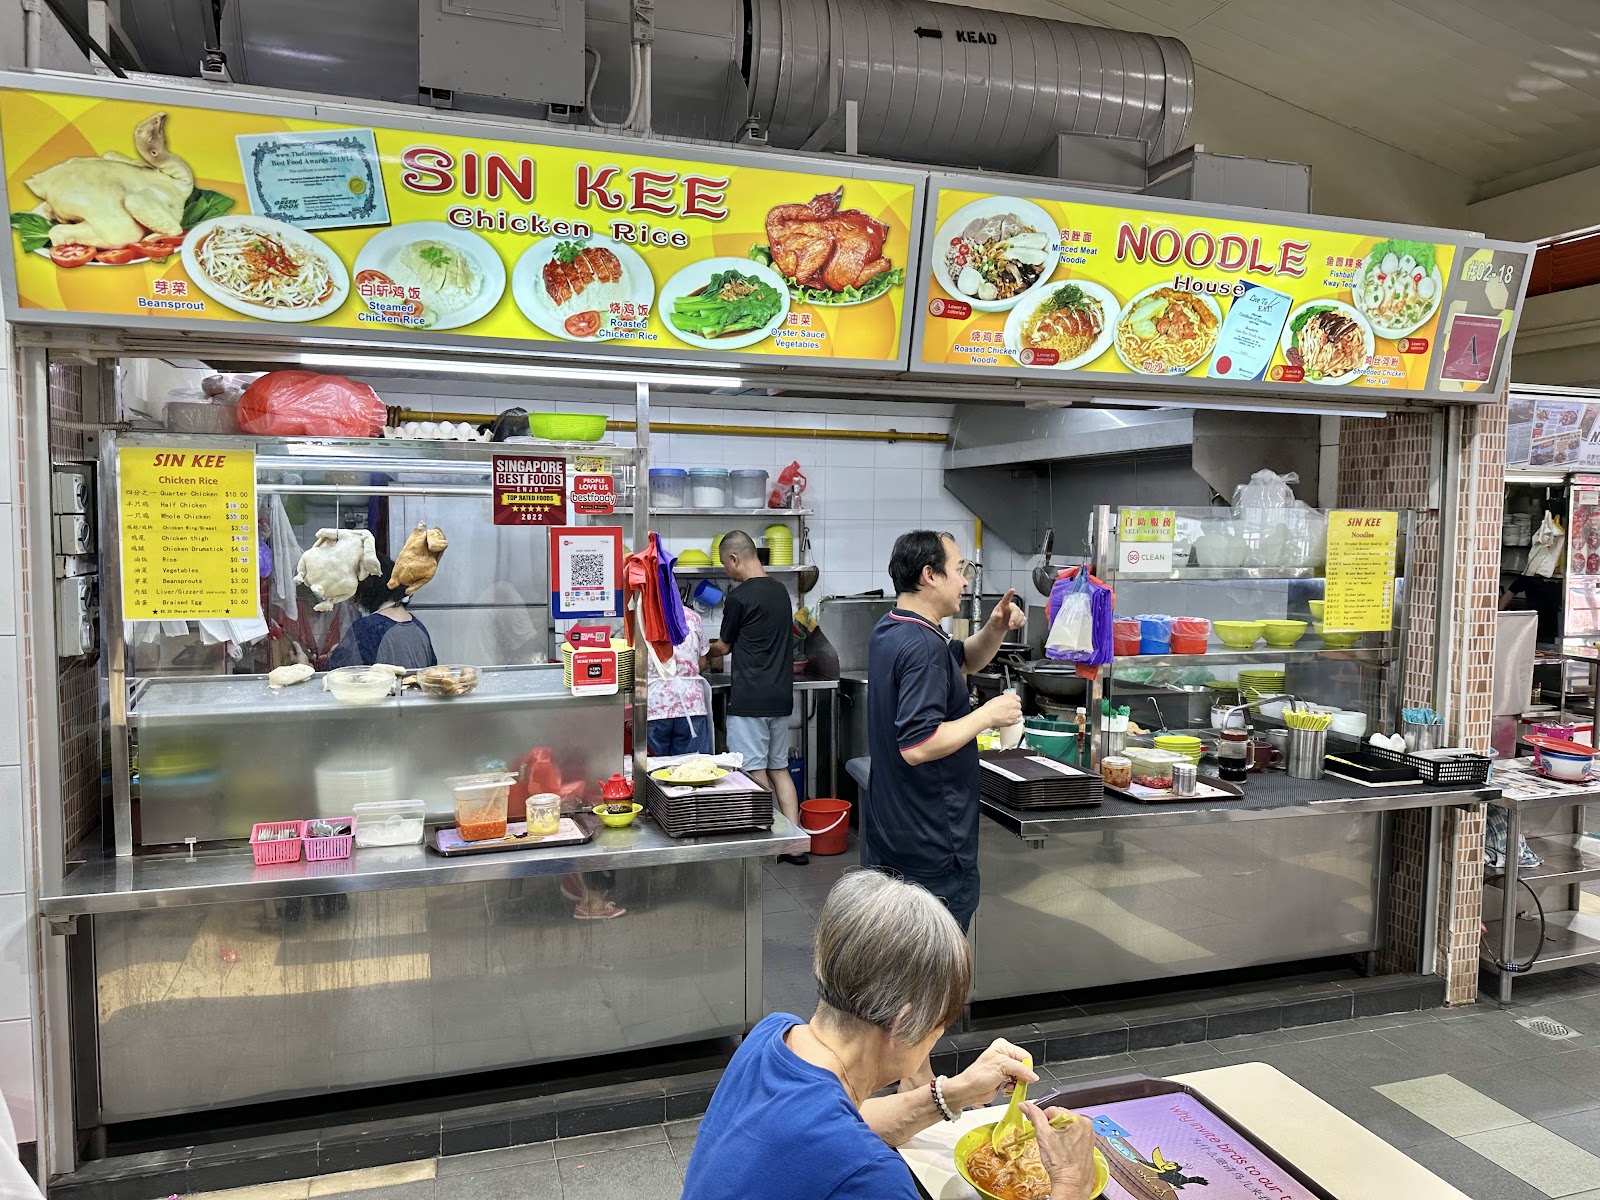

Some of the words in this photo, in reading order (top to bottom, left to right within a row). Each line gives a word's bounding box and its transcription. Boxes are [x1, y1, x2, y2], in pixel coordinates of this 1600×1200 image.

[402, 146, 535, 202] SIN
[576, 164, 731, 220] KEE
[448, 207, 591, 238] Chicken
[613, 221, 689, 247] Rice
[1052, 243, 1078, 254] Minced
[1080, 245, 1098, 255] Meat
[1115, 222, 1311, 277] NOODLE
[1060, 255, 1086, 265] Noodle
[1330, 270, 1355, 279] Fishball
[1467, 260, 1514, 284] #02-18
[154, 280, 188, 296] 芽菜
[1174, 274, 1245, 297] House
[1323, 279, 1340, 288] Kway
[1342, 280, 1358, 288] Teow
[360, 283, 421, 300] 白斩鸡饭
[138, 297, 205, 312] Beansprout
[369, 301, 414, 313] Steamed
[609, 302, 649, 317] 烧鸡饭
[358, 312, 400, 324] Chicken
[401, 315, 426, 325] Rice
[610, 318, 647, 329] Roasted
[787, 313, 811, 326] 油菜
[599, 328, 637, 339] Chicken
[638, 331, 659, 341] Rice
[771, 328, 801, 339] Oyster
[803, 329, 825, 339] Sauce
[970, 331, 1003, 344] 烧鸡面
[775, 339, 820, 349] Vegetables
[954, 344, 985, 355] Roasted
[986, 345, 1017, 356] Chicken
[1456, 333, 1480, 365] A
[971, 355, 998, 365] Noodle
[1166, 365, 1186, 373] Laksa
[1353, 367, 1381, 376] Shredded
[1382, 369, 1406, 378] Chicken
[153, 453, 187, 467] SIN
[191, 454, 227, 468] KEE
[496, 459, 563, 474] SINGAPORE
[158, 475, 196, 485] Chicken
[199, 476, 219, 485] Rice
[498, 474, 524, 484] BEST
[527, 474, 561, 485] FOODS
[125, 489, 157, 497] 四分之一
[160, 490, 187, 498] Quarter
[190, 490, 219, 498] Chicken
[571, 491, 616, 506] bestfoody
[1347, 518, 1362, 527] SIN
[1364, 518, 1382, 527] KEE
[190, 535, 209, 543] thigh
[162, 567, 199, 575] Vegetables
[162, 578, 203, 586] Beansprouts
[156, 588, 204, 596] Liver/Gizzard
[1170, 1105, 1194, 1123] Why
[1190, 1119, 1221, 1143] invite
[1217, 1143, 1248, 1165] birds
[1245, 1165, 1261, 1176] to
[1258, 1177, 1283, 1194] our
